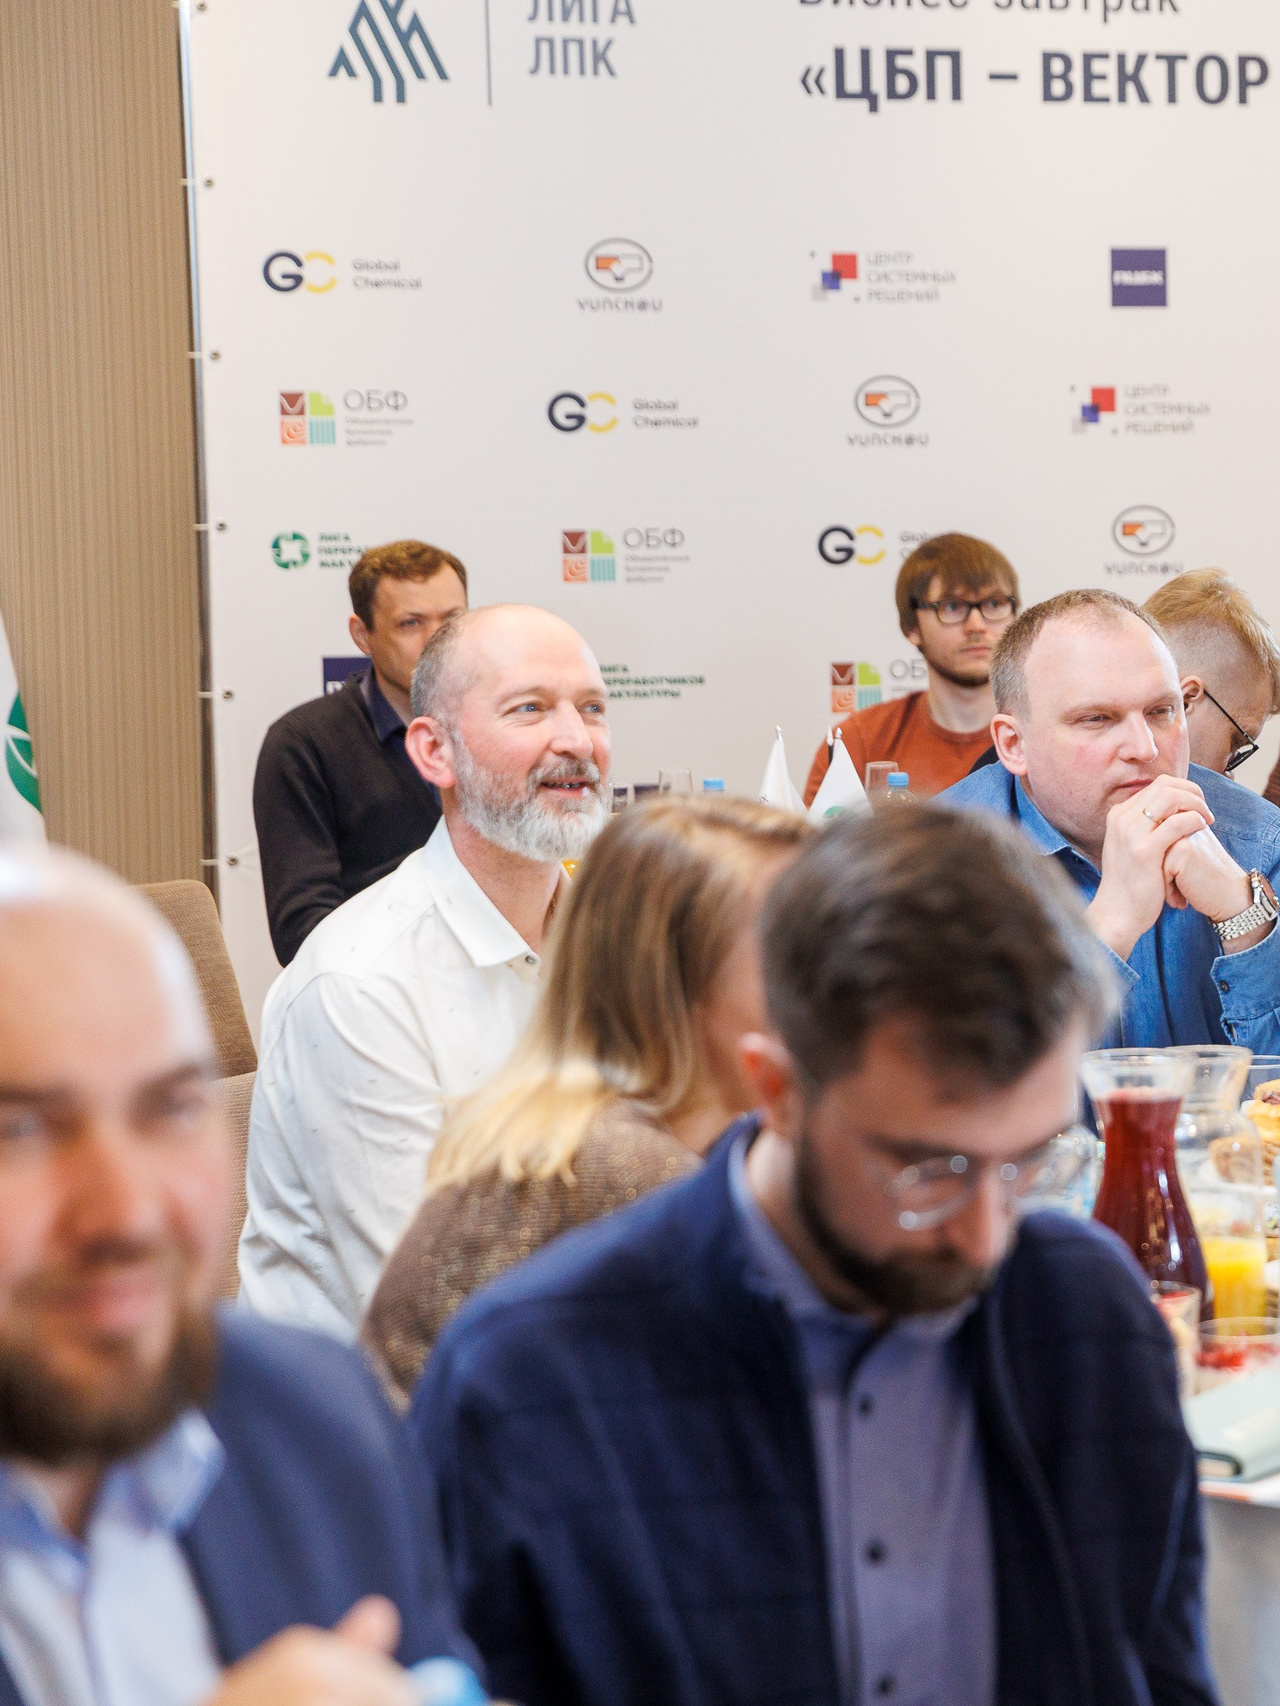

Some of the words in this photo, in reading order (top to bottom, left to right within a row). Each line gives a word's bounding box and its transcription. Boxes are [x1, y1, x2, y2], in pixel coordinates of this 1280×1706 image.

[529, 36, 616, 77] ЛПК
[800, 47, 962, 113] «ЦБП
[1041, 52, 1269, 105] ВЕКТОР
[353, 257, 400, 272] Global
[353, 275, 422, 291] Chemical
[343, 389, 408, 412] ОБФ
[633, 397, 679, 412] Global
[633, 415, 700, 430] Chemical
[622, 527, 686, 550] ОБФ
[889, 659, 927, 679] ОБ
